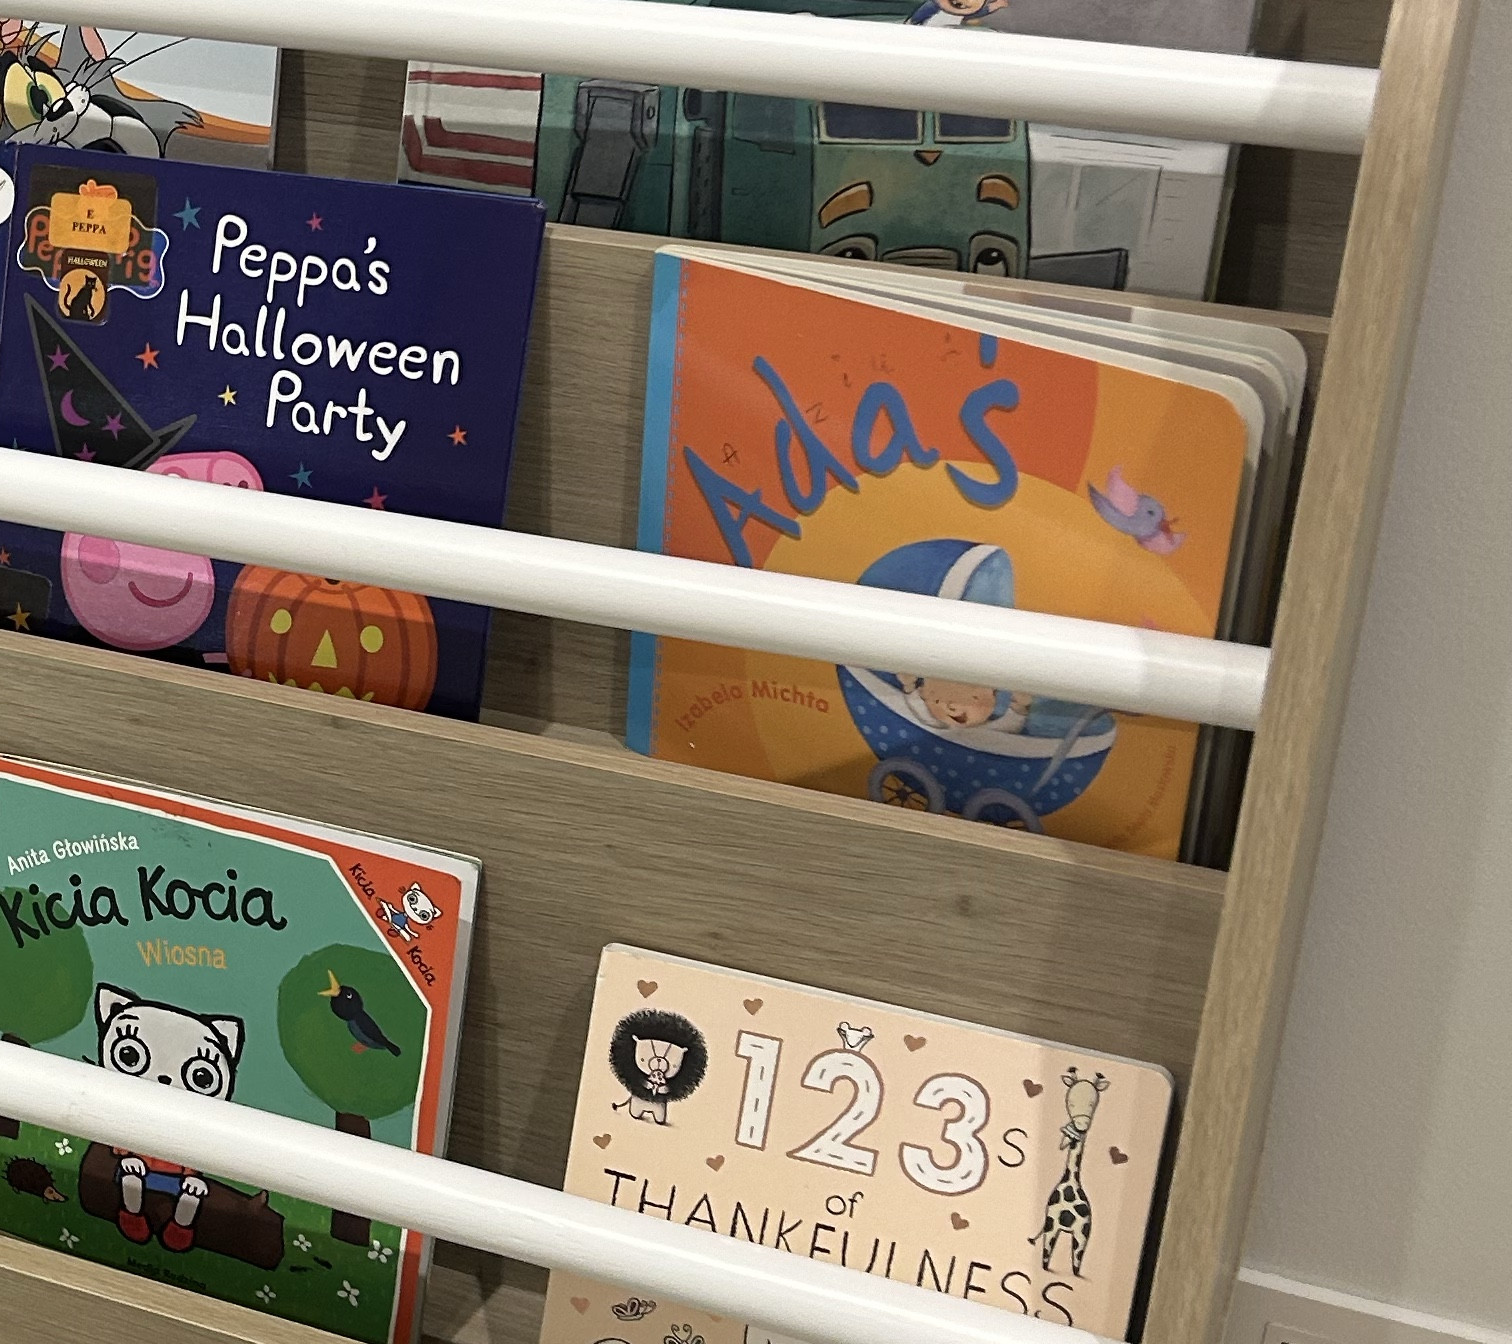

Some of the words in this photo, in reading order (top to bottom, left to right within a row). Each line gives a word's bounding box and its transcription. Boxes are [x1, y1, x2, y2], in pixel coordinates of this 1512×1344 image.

[71, 220, 108, 235] PEPPA
[85, 208, 95, 220] E
[211, 214, 391, 307] Peppa's
[175, 289, 460, 385] Halloween
[265, 369, 406, 462] Party
[750, 679, 831, 714] Michta
[6, 847, 52, 877] Anita
[52, 830, 140, 861] Głowińska
[136, 864, 288, 932] Kocia
[348, 862, 377, 900] Kicia
[136, 938, 228, 971] Wiosna
[406, 945, 436, 987] Kocia
[825, 1191, 864, 1219] of
